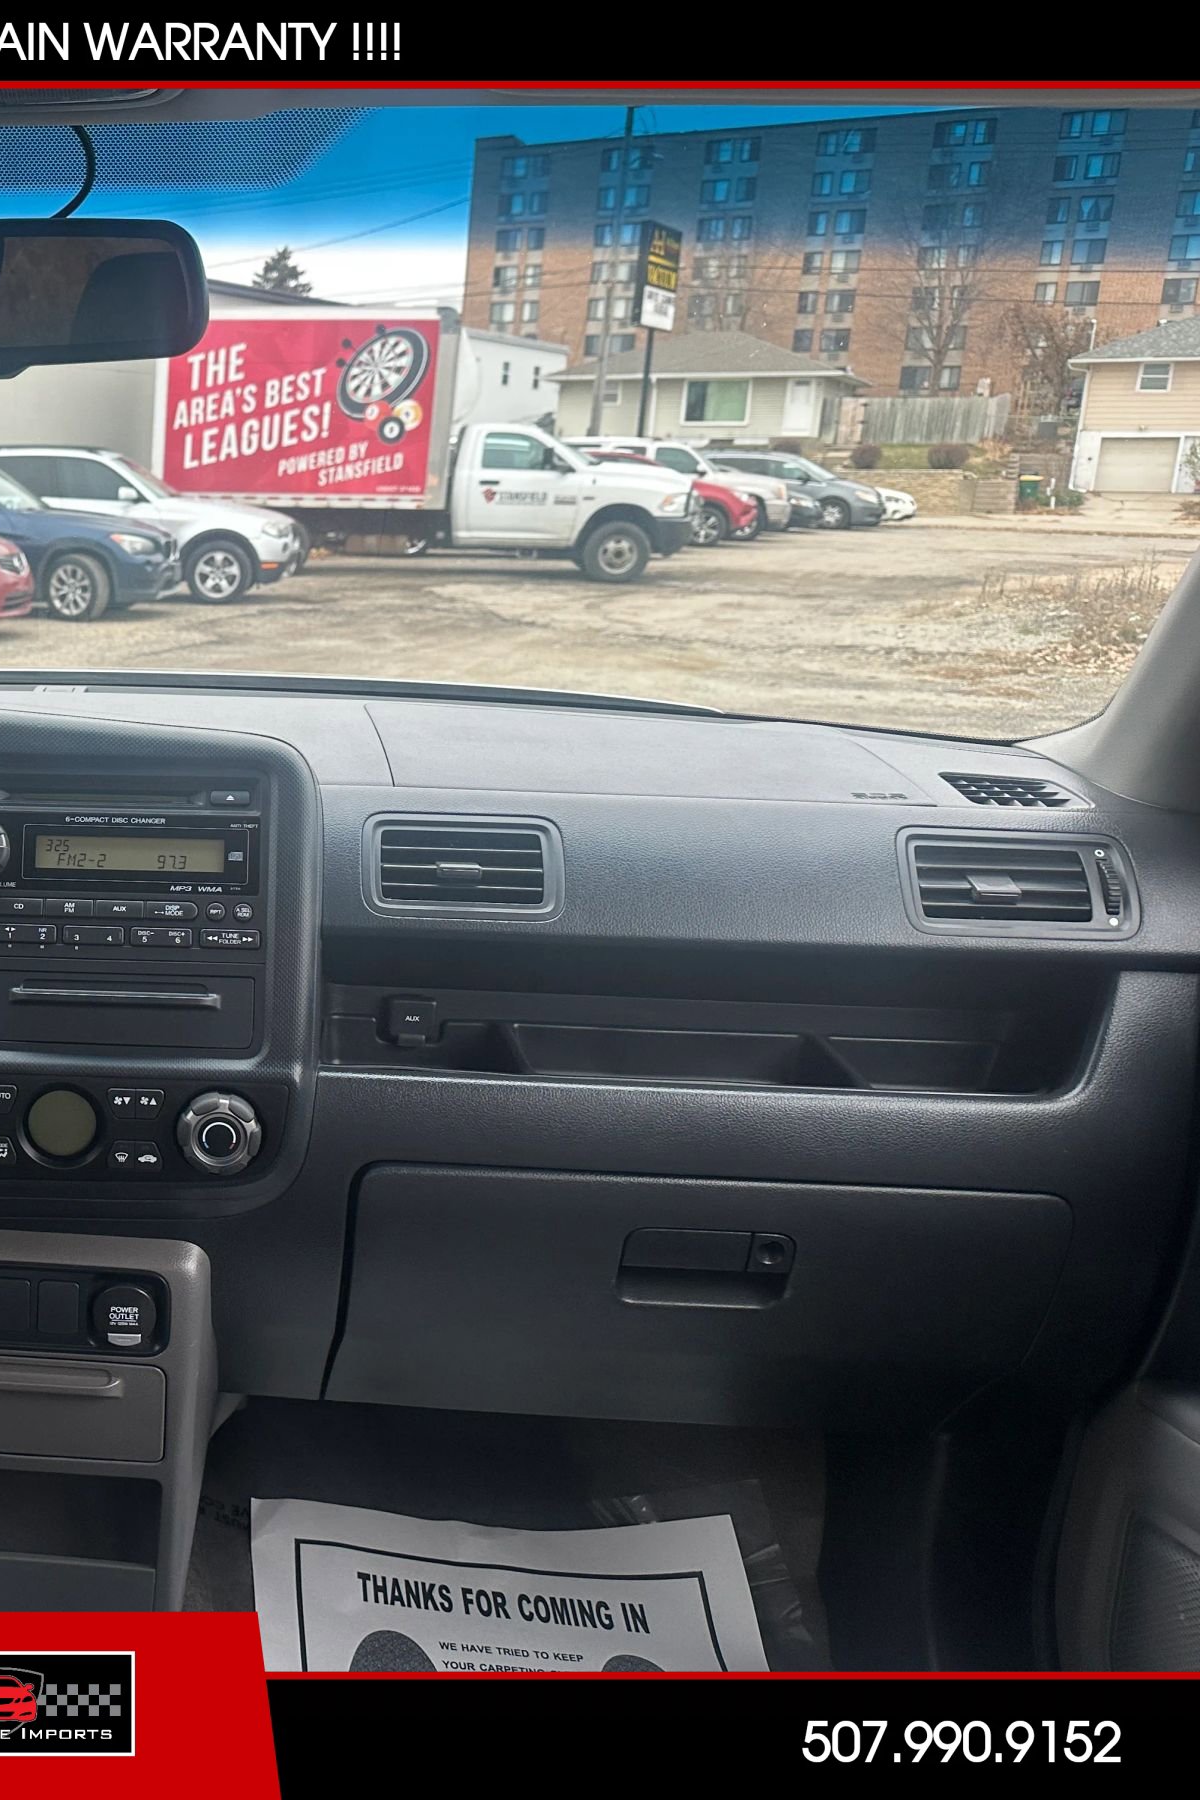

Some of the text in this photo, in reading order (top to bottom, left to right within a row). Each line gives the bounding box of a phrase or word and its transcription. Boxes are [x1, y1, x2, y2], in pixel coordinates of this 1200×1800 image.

[187, 343, 247, 392] THE
[172, 367, 327, 431] AREA'S BEST
[182, 401, 332, 470] LEAGUES!
[277, 441, 369, 478] POWERED BY
[316, 451, 405, 487] STANSFIELD
[65, 815, 167, 825] 6-COMPACT DISC CHANGER
[45, 838, 70, 852] 325
[56, 852, 107, 869] FM2-2
[108, 1312, 140, 1320] OUTLET
[110, 1306, 139, 1314] POWER
[356, 1571, 651, 1634] THANKS FOR COMING IN
[438, 1641, 584, 1663] WE HAVE TRIED TO KEEP
[441, 1660, 476, 1671] YOUR
